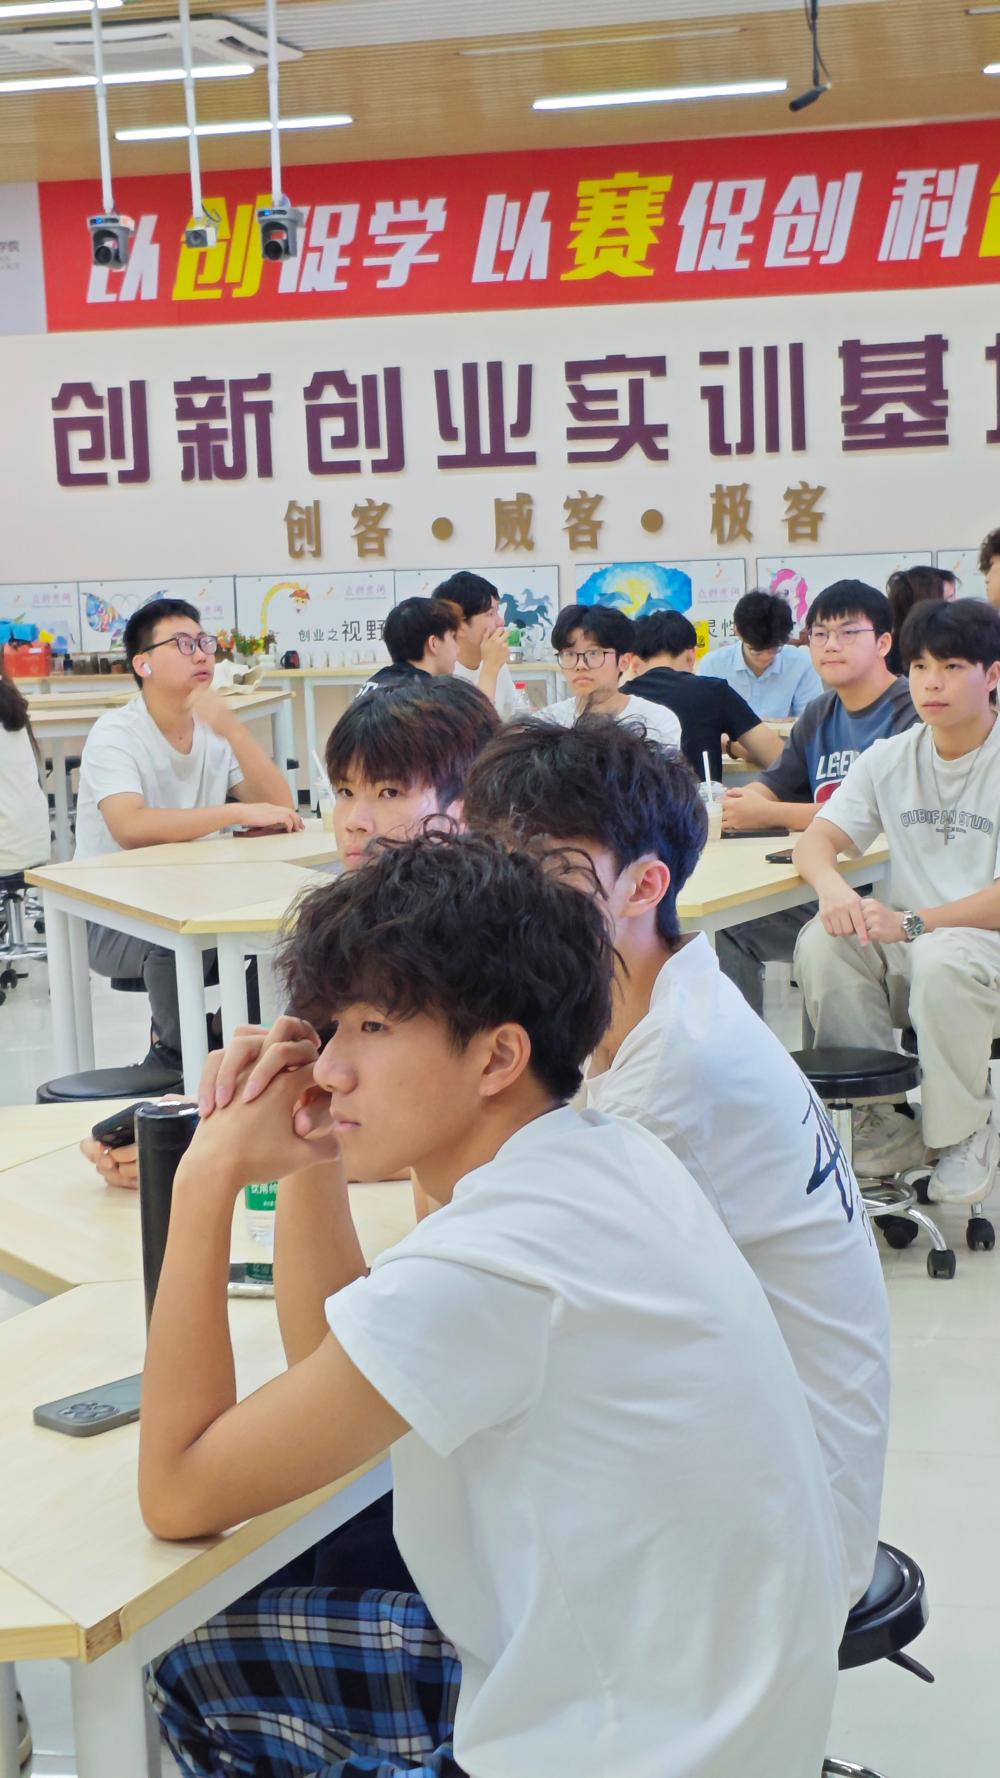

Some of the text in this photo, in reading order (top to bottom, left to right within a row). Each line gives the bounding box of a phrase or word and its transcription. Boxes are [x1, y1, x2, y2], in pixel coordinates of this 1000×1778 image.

[86, 163, 1000, 303] 以创促学 以赛促创 科
[52, 332, 1000, 487] 创新创业实训基
